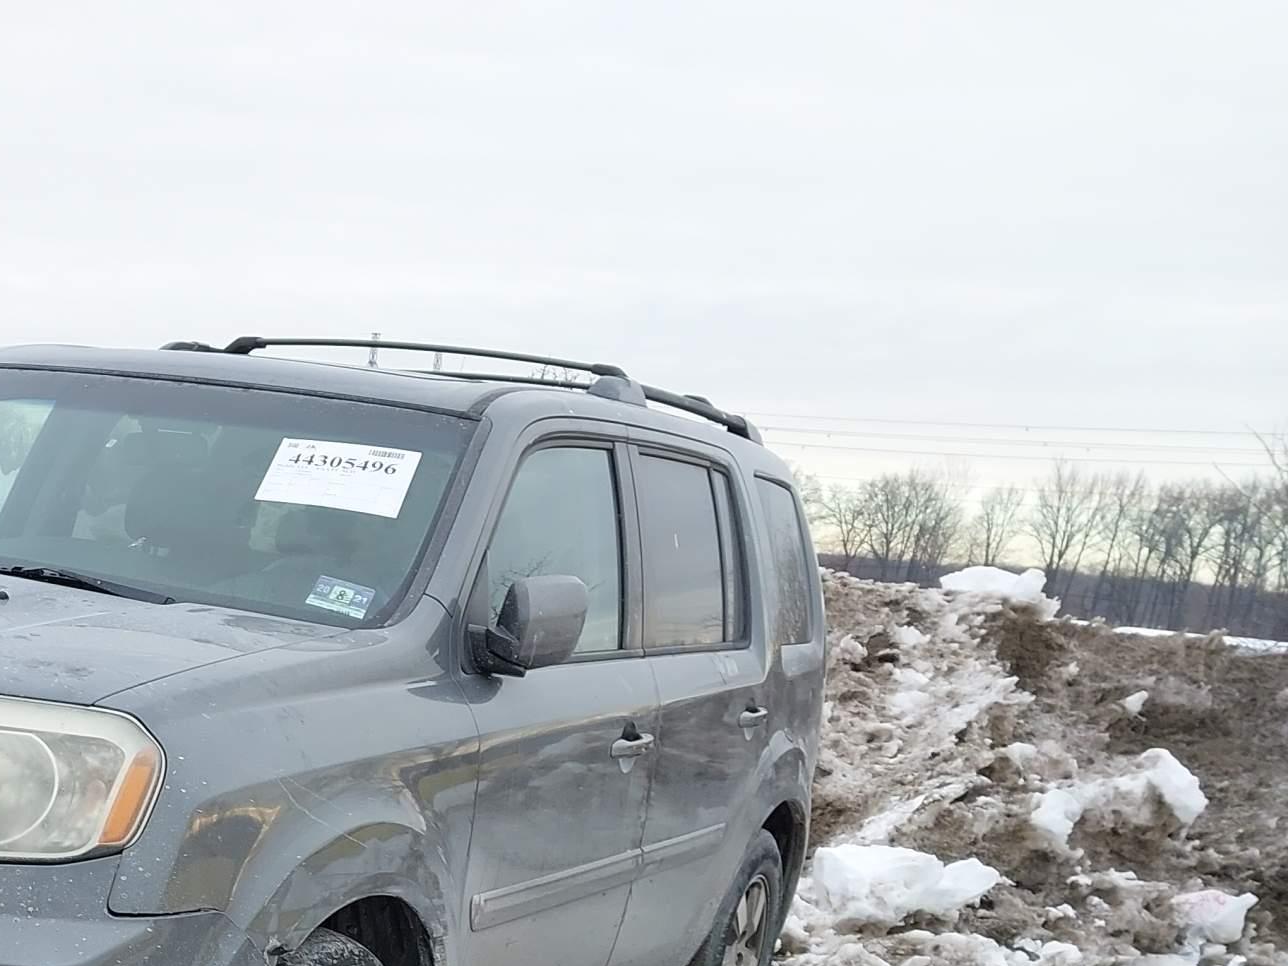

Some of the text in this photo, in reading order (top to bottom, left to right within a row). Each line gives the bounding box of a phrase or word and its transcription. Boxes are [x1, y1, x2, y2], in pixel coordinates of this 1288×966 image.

[289, 453, 399, 475] 44305496
[336, 590, 347, 601] 8
[352, 595, 368, 604] 21
